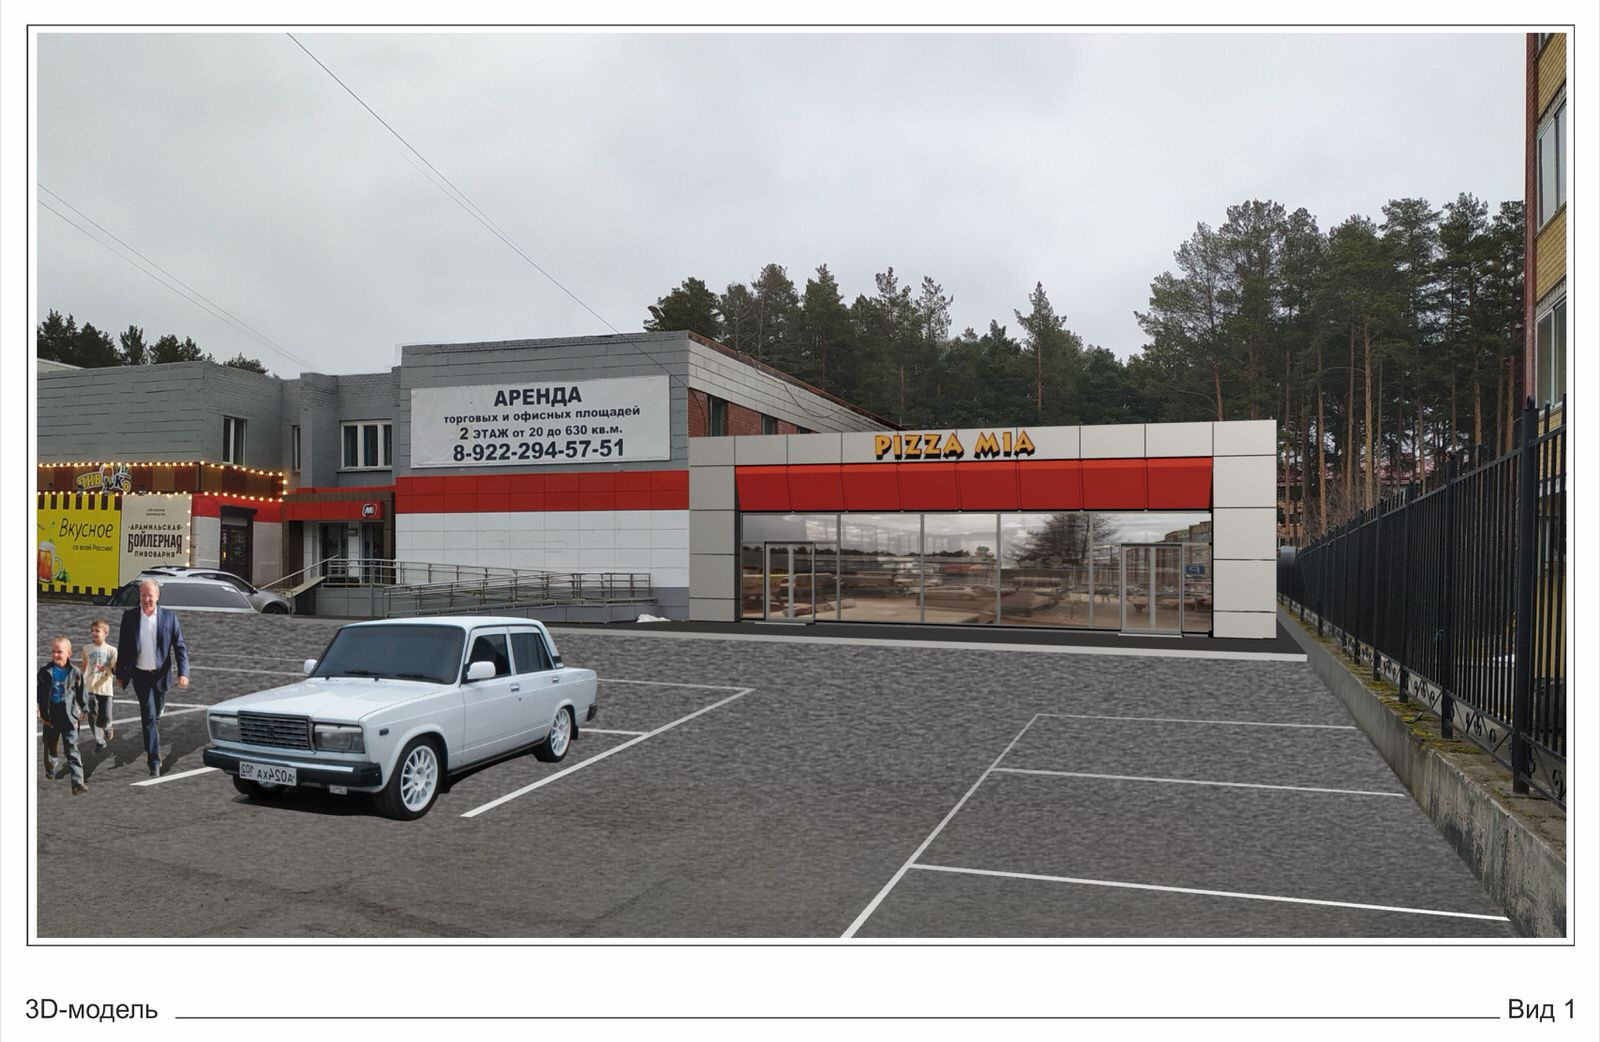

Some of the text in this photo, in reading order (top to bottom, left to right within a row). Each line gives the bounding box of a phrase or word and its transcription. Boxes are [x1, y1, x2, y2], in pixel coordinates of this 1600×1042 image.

[494, 386, 582, 407] АРЕНДА
[443, 405, 640, 425] торговых и офисных площадей
[459, 424, 623, 440] 2 ЭТАЖ от 20 до 630 кв.м.
[453, 438, 624, 462] 8-922-294-57-51
[874, 430, 1035, 460] PIZZA MIA
[59, 517, 114, 541] Вкусное
[127, 530, 183, 554] БОЙЛЕРНАЯ
